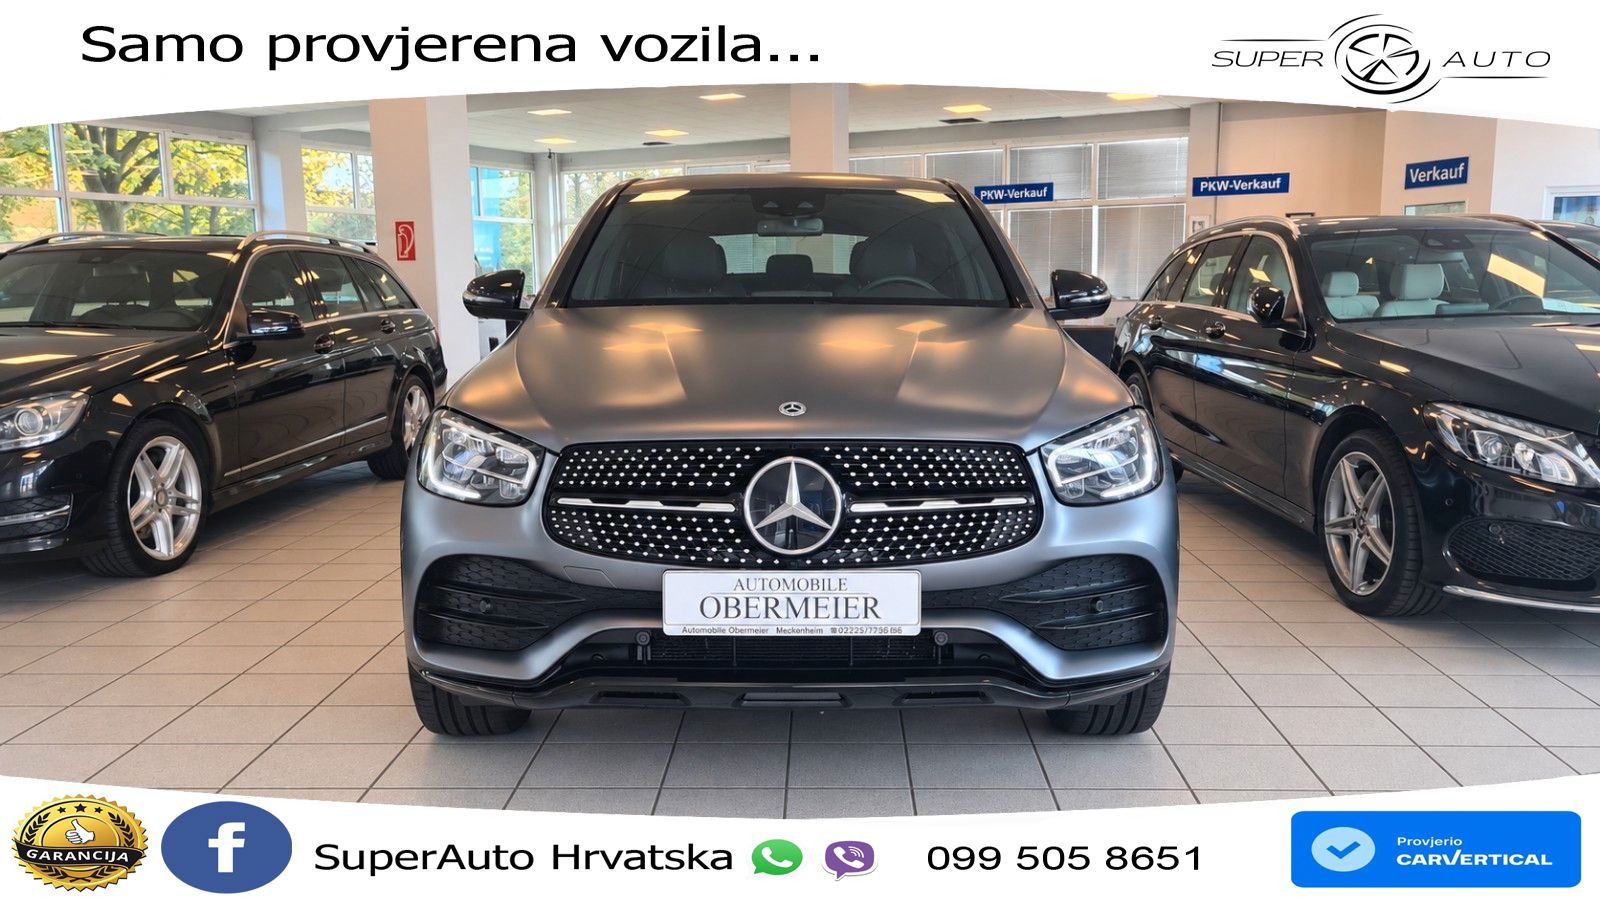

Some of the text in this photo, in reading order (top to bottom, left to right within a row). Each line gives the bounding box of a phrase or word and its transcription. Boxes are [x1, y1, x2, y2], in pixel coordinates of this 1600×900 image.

[1409, 162, 1465, 184] Verkauf
[1200, 177, 1282, 192] PKW-Verkauf
[980, 186, 1048, 201] PKW-Verkauf
[733, 577, 848, 592] AUTOMOBILE
[699, 595, 882, 620] OBERMEIER
[681, 626, 727, 635] Automobile
[728, 626, 769, 635] Obermeier
[776, 626, 824, 635] Meckenheim
